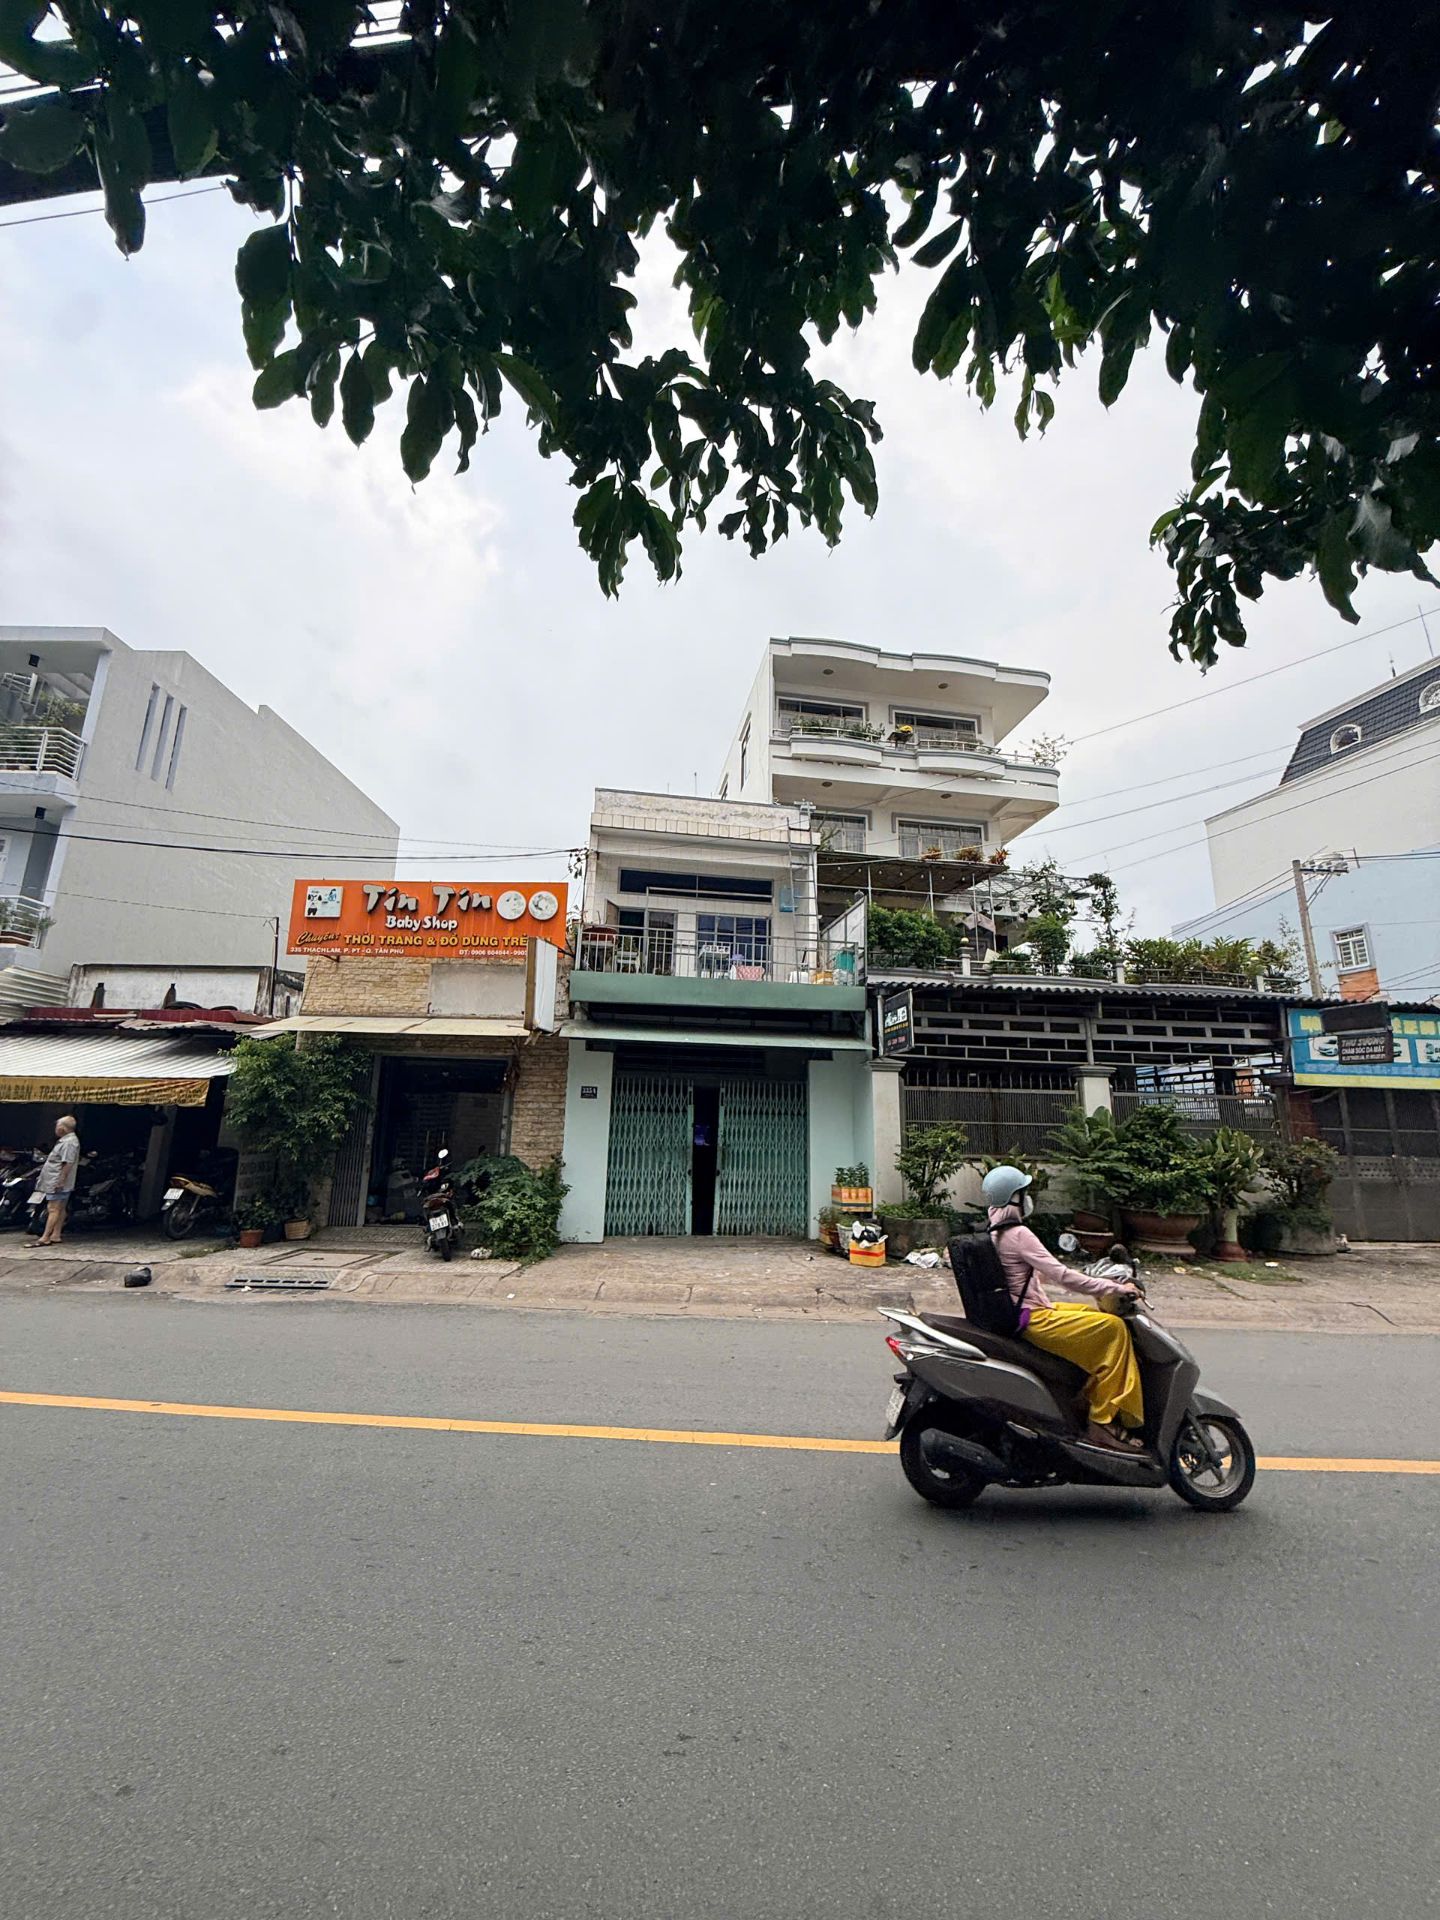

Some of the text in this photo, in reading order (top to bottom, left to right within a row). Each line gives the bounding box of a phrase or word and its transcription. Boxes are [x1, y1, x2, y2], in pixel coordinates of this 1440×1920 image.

[386, 915, 458, 931] Baby Shop
[379, 935, 423, 945] TRANG
[426, 936, 437, 945] &
[462, 933, 499, 946] DÙNG
